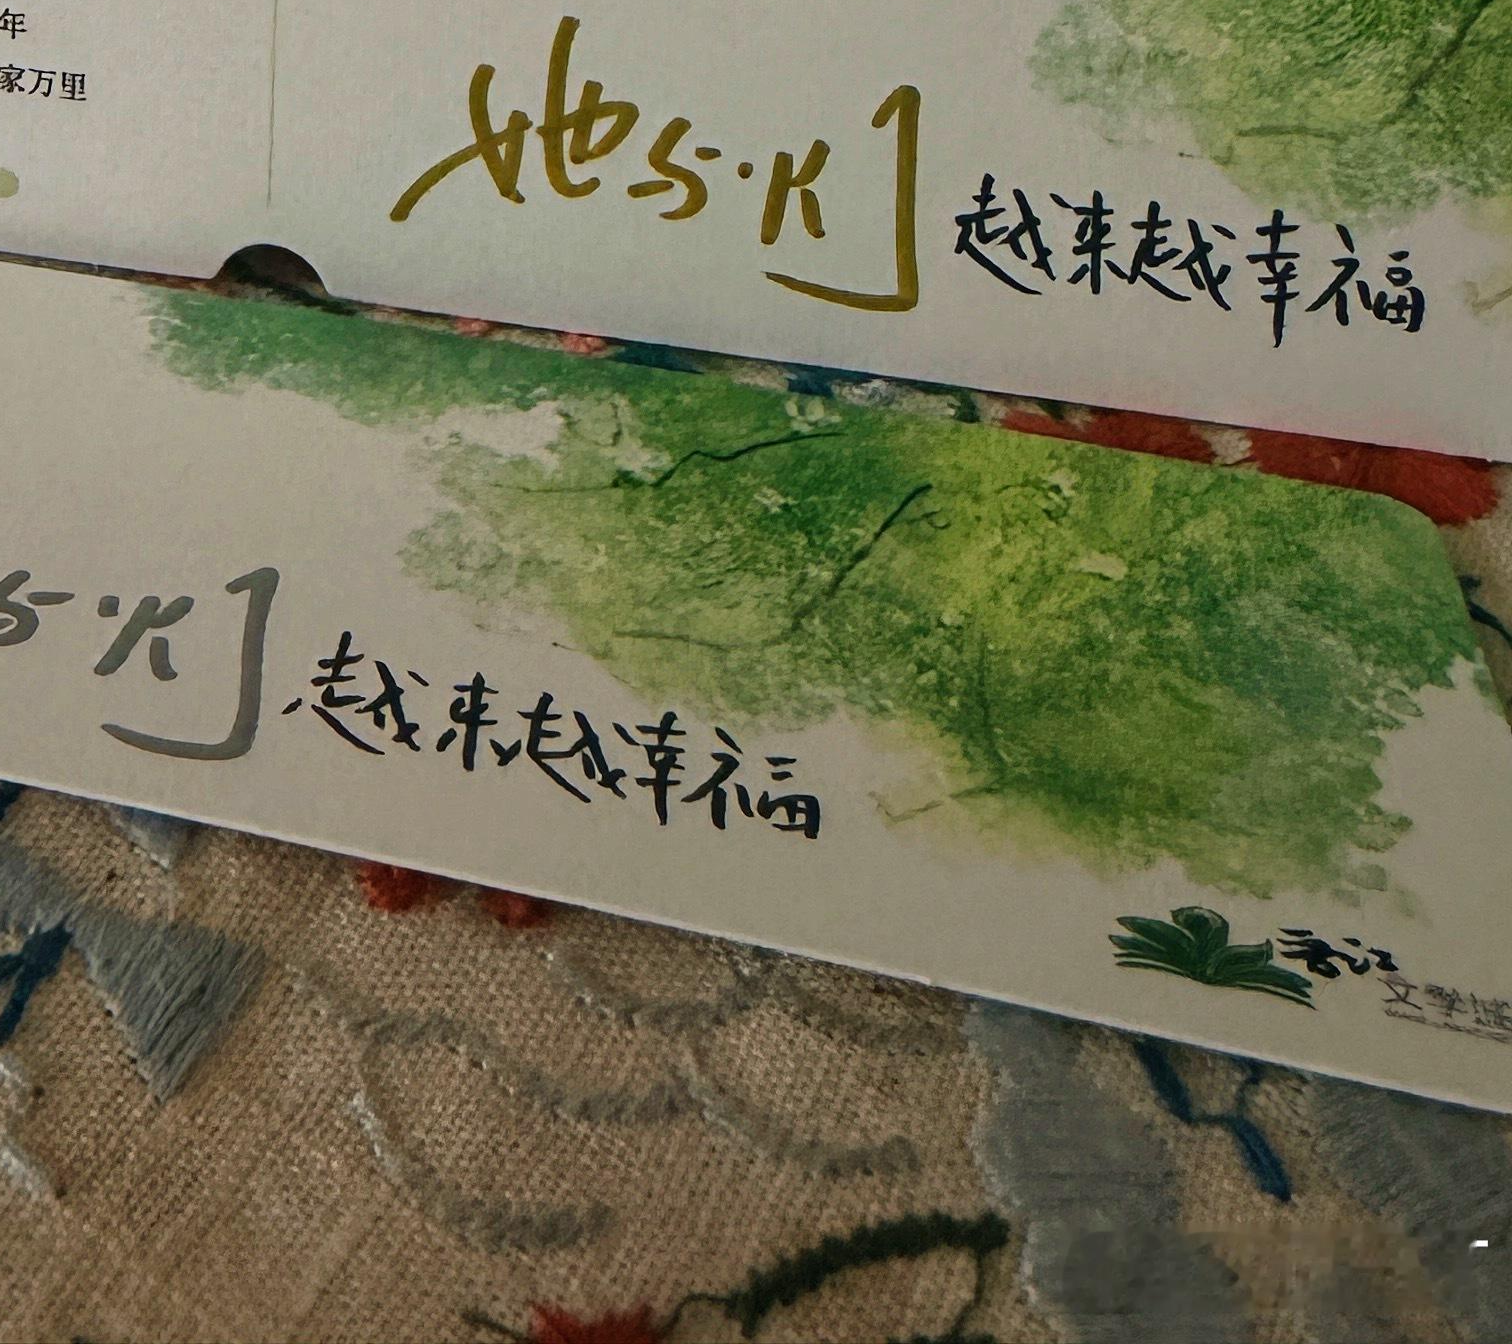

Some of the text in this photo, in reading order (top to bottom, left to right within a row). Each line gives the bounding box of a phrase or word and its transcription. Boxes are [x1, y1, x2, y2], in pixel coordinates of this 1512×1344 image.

[953, 171, 1428, 349] 越来越幸福
[281, 630, 824, 840] 越来越幸福
